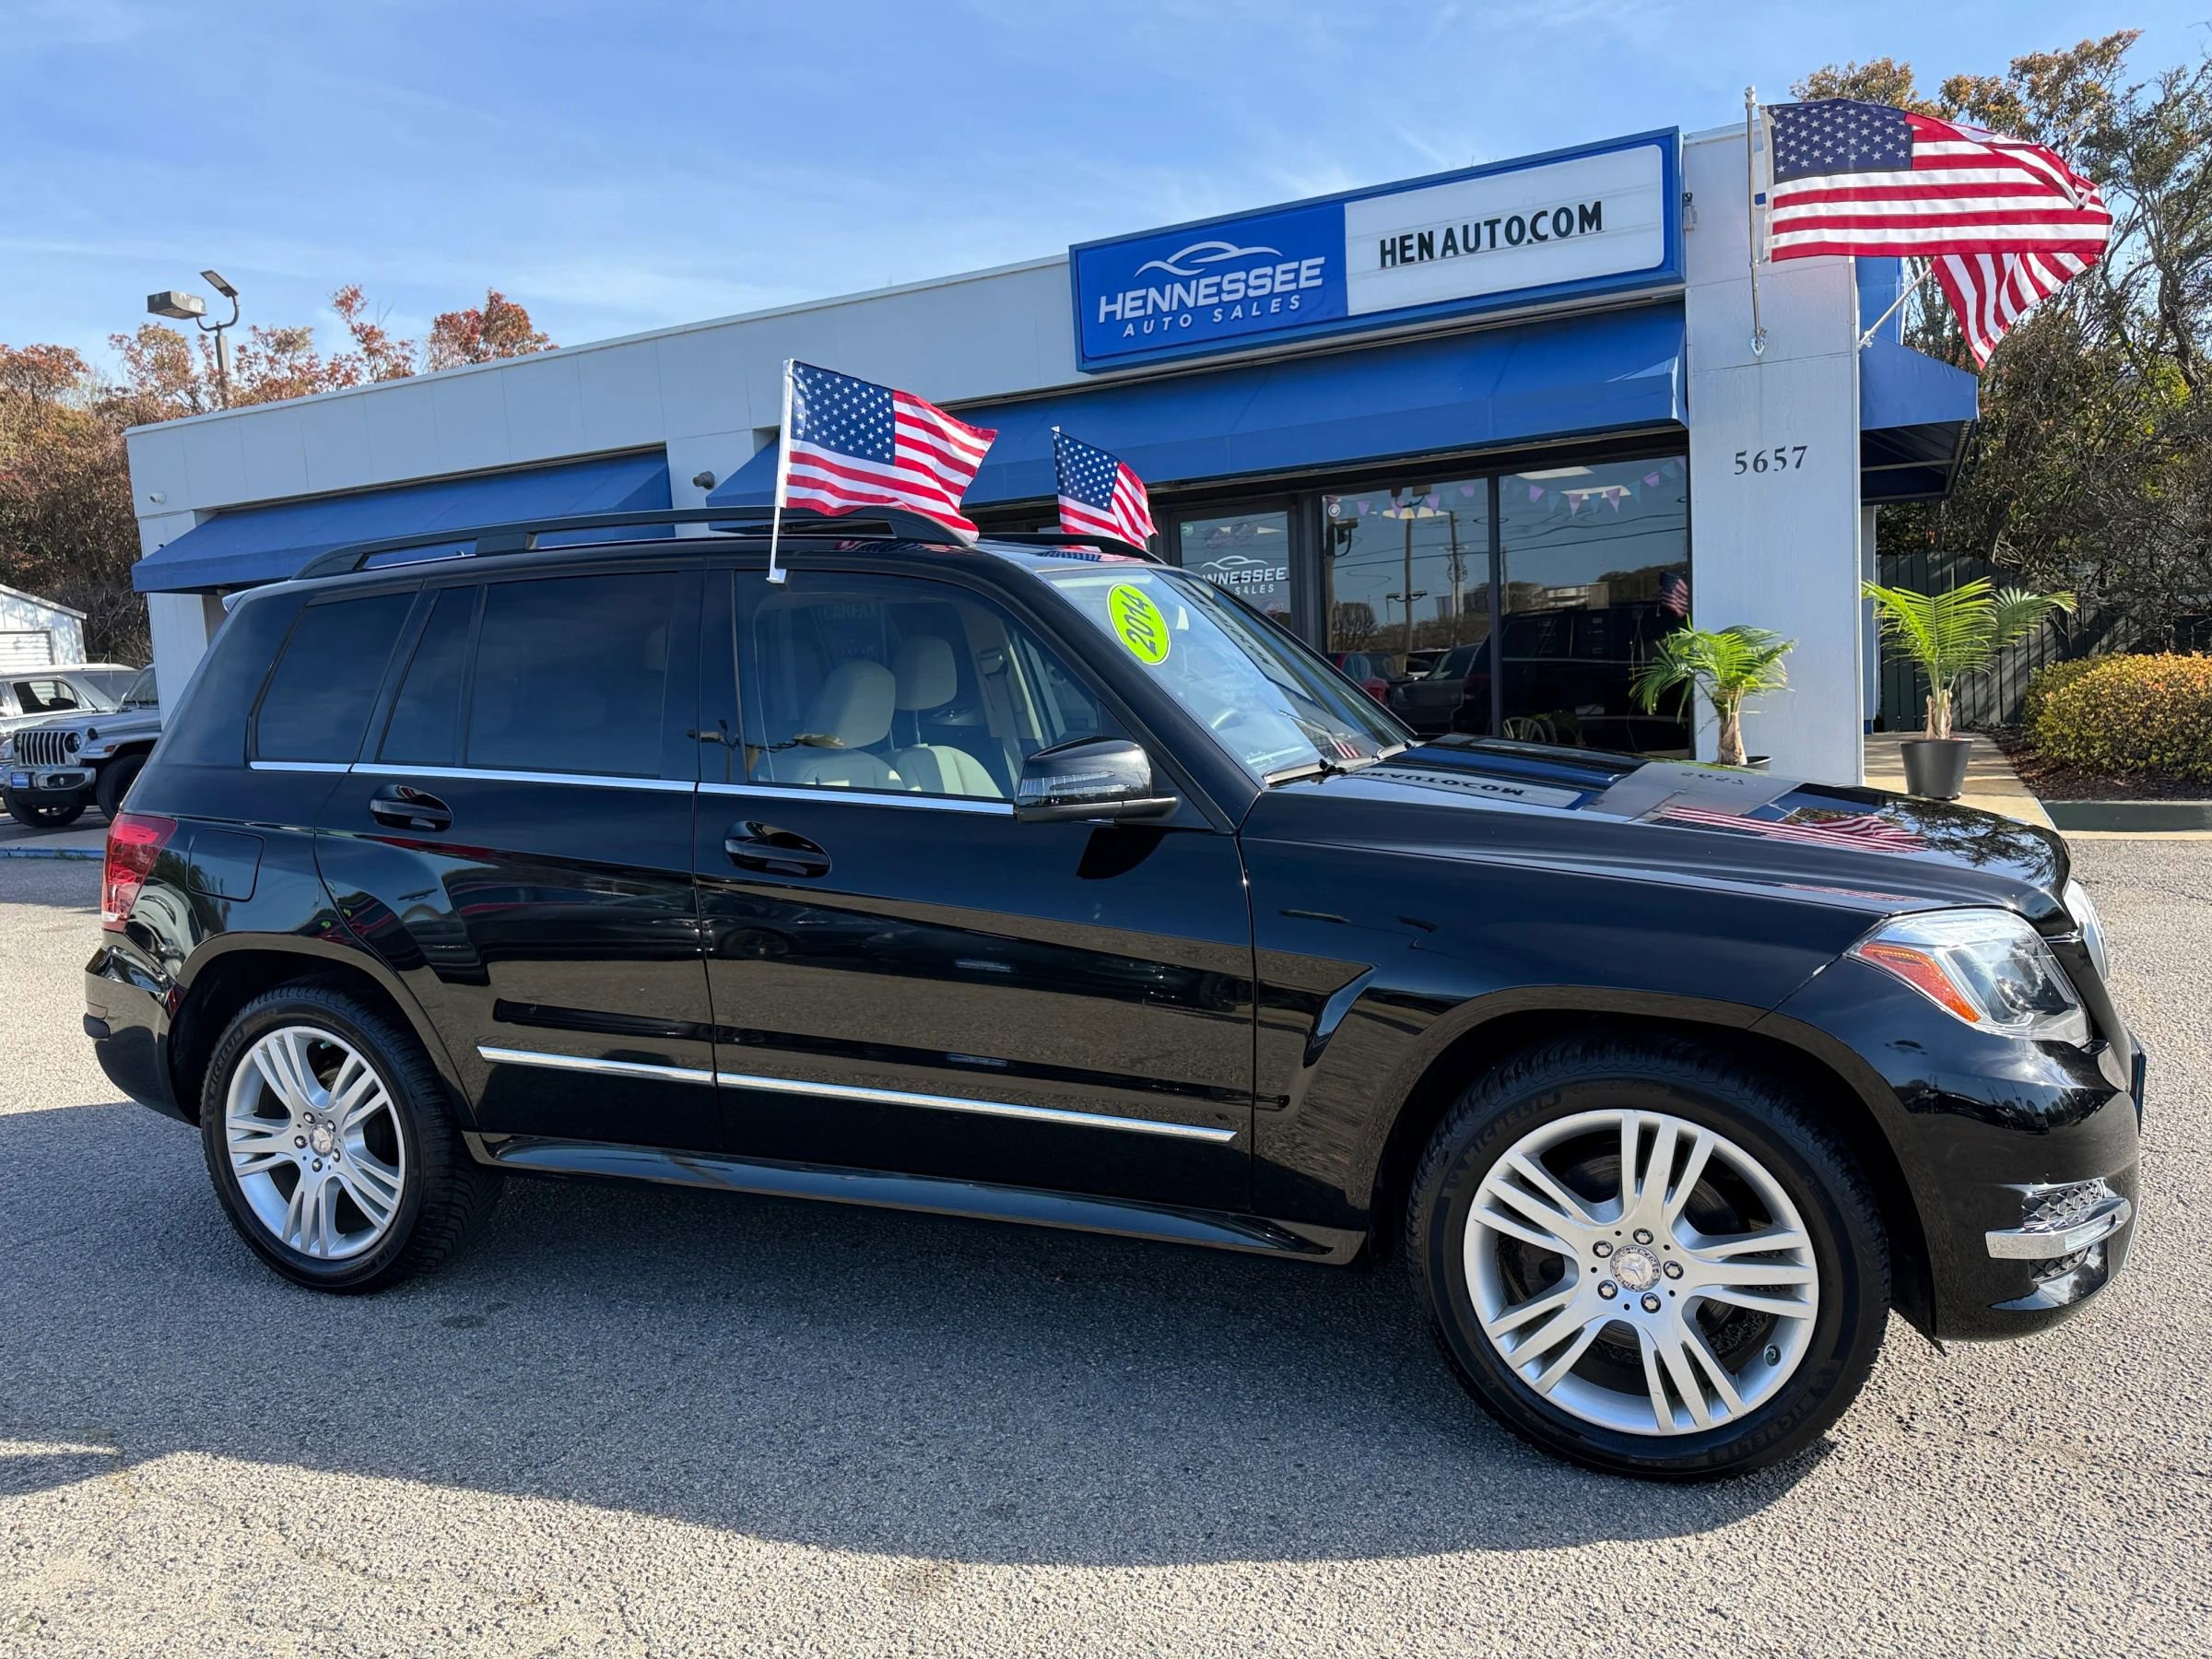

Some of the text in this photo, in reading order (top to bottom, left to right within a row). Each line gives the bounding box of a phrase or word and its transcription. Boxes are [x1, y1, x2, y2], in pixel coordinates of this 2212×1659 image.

[1380, 200, 1602, 267] HENAUTO.COM
[1099, 256, 1325, 324] HENNESSEE
[1123, 294, 1301, 337] AUTO SALES
[1734, 445, 1808, 476] 5657
[1202, 567, 1288, 585] NNESSEE
[1235, 583, 1275, 596] SALES
[1119, 588, 1158, 657] 2014
[1463, 1091, 1557, 1166] MICHELIN
[1714, 1391, 1817, 1462] MICHELIN
